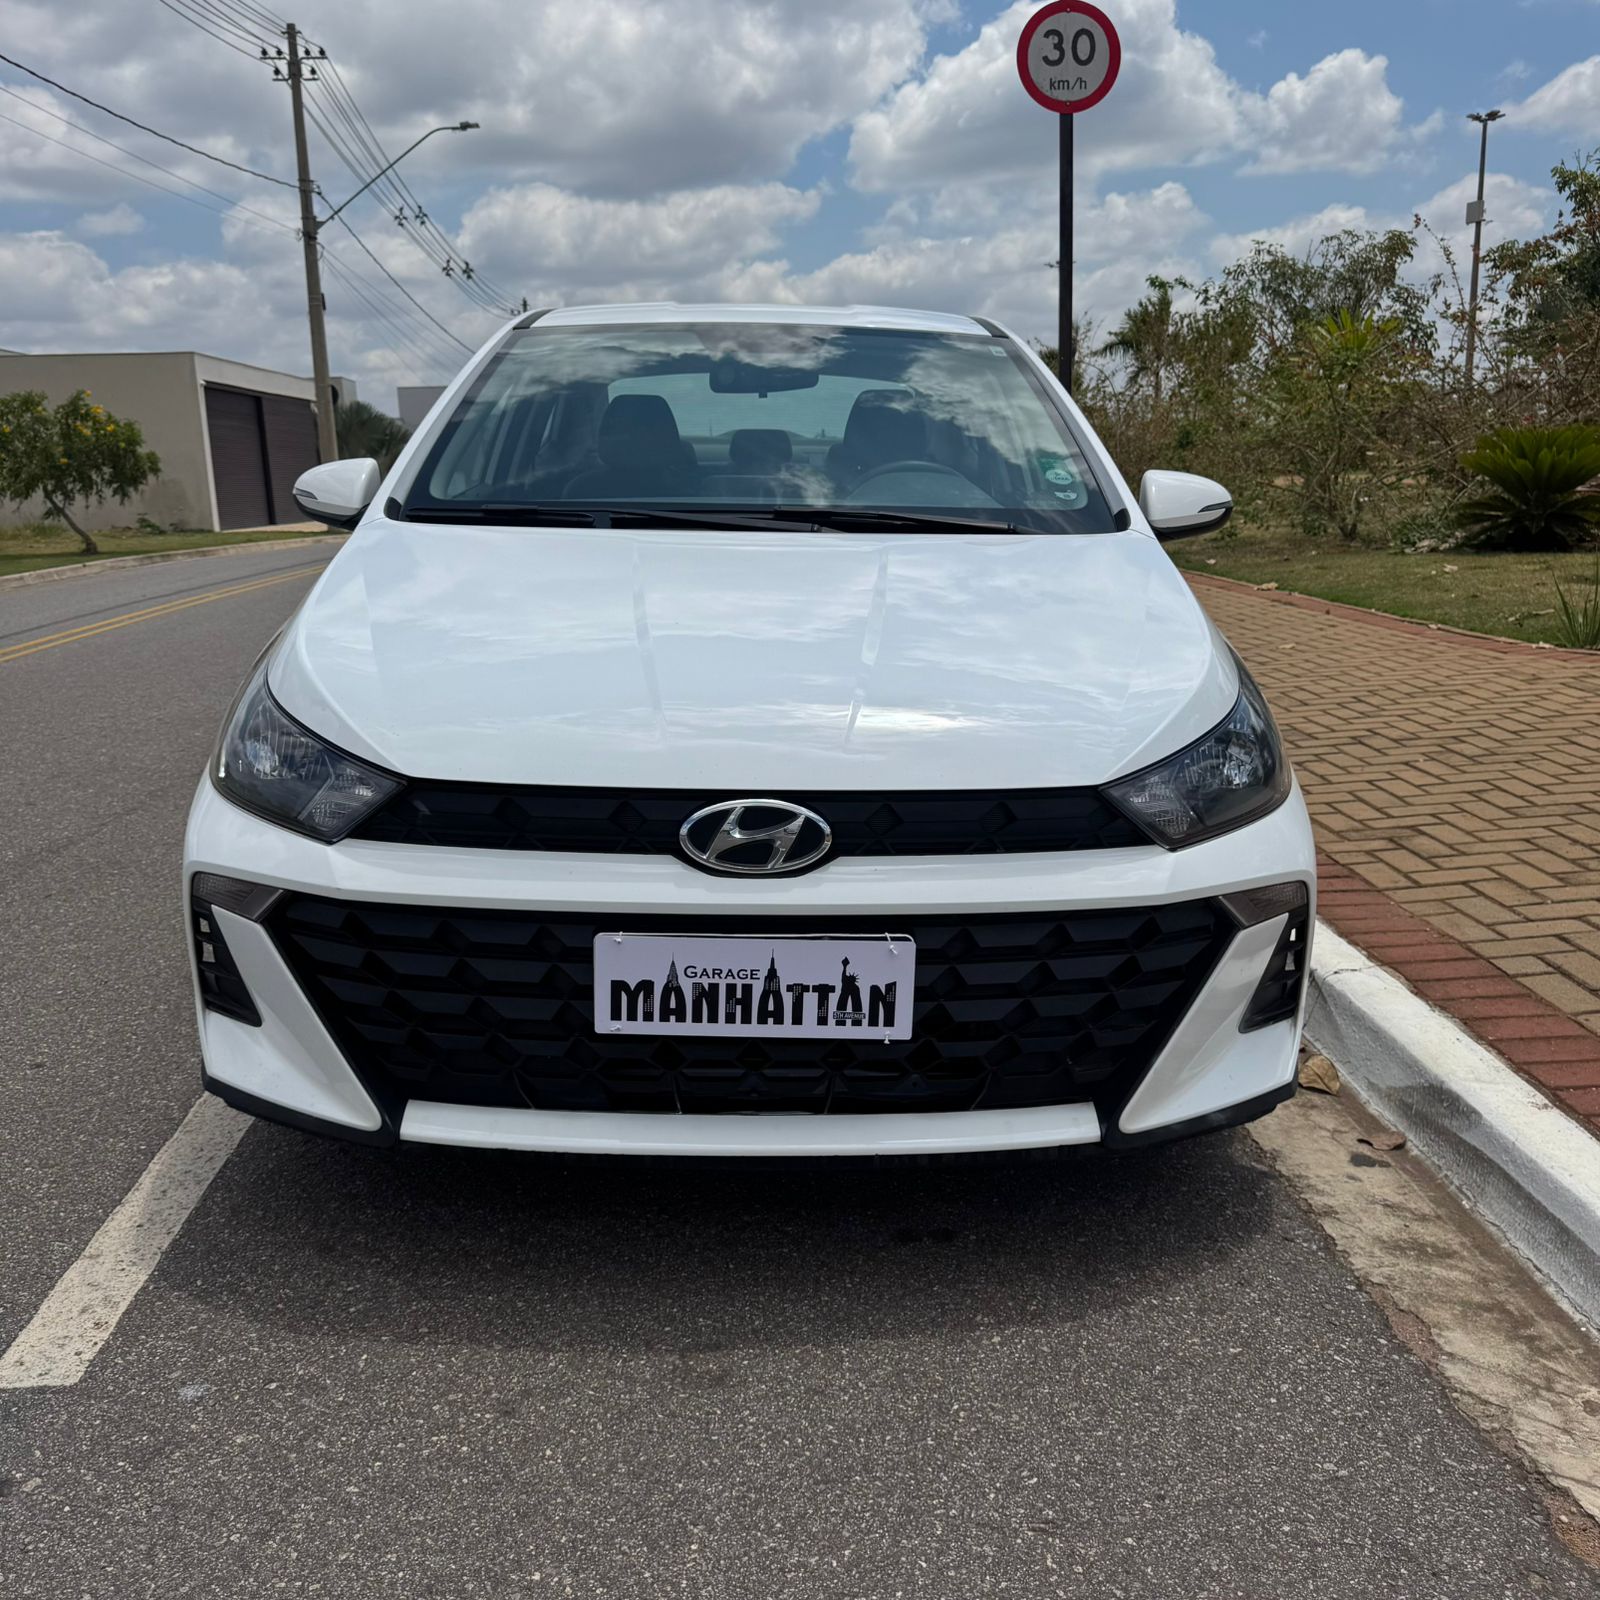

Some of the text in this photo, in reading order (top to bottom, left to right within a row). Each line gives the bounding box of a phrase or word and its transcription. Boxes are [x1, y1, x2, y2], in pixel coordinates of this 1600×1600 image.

[1042, 27, 1096, 67] 30
[1049, 77, 1087, 91] km/h
[683, 965, 760, 980] GARAGE
[610, 974, 897, 1027] MANHATTAN
